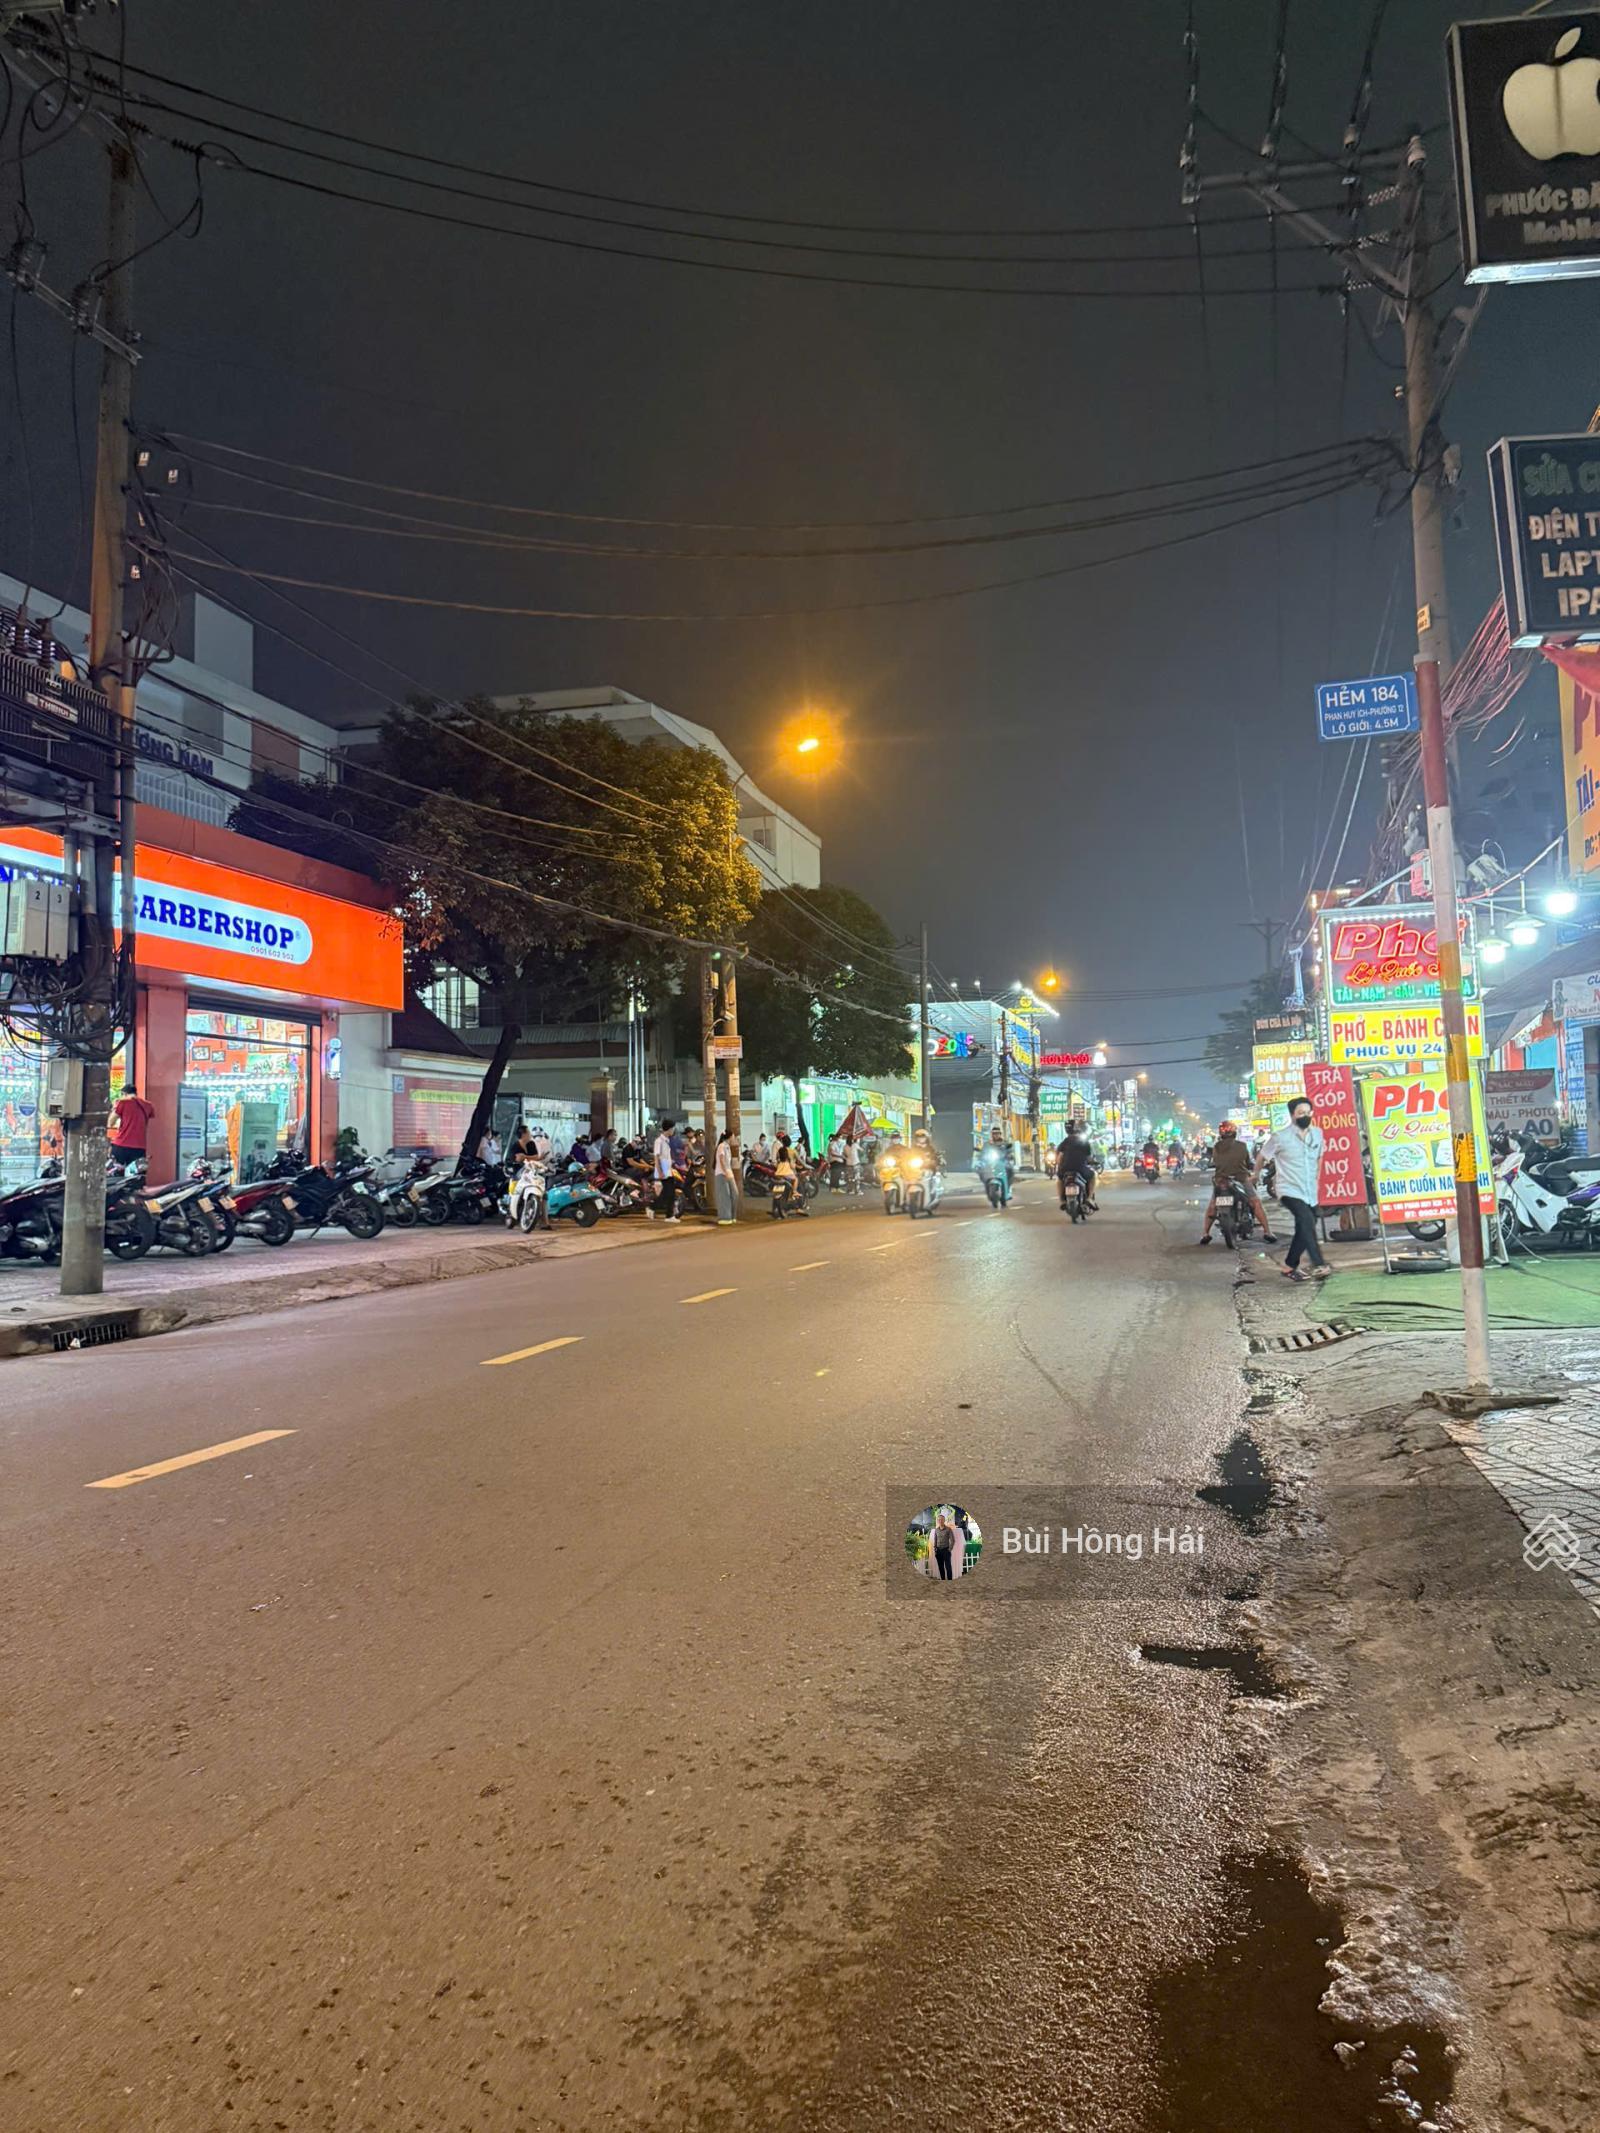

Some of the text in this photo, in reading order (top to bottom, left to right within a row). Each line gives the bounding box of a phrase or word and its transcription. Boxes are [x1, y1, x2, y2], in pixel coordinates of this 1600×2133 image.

[1528, 507, 1580, 545] ĐIỆN
[1326, 684, 1400, 708] HẺM 184
[1375, 717, 1399, 729] 4.5M
[36, 891, 41, 900] 2
[57, 894, 62, 904] 3
[1333, 1014, 1366, 1043] PHỞ
[1383, 1015, 1428, 1040] BÁNH
[1314, 1088, 1346, 1108] GÓP
[1379, 1175, 1406, 1196] BÁNH
[1410, 1172, 1437, 1193] CUỐN
